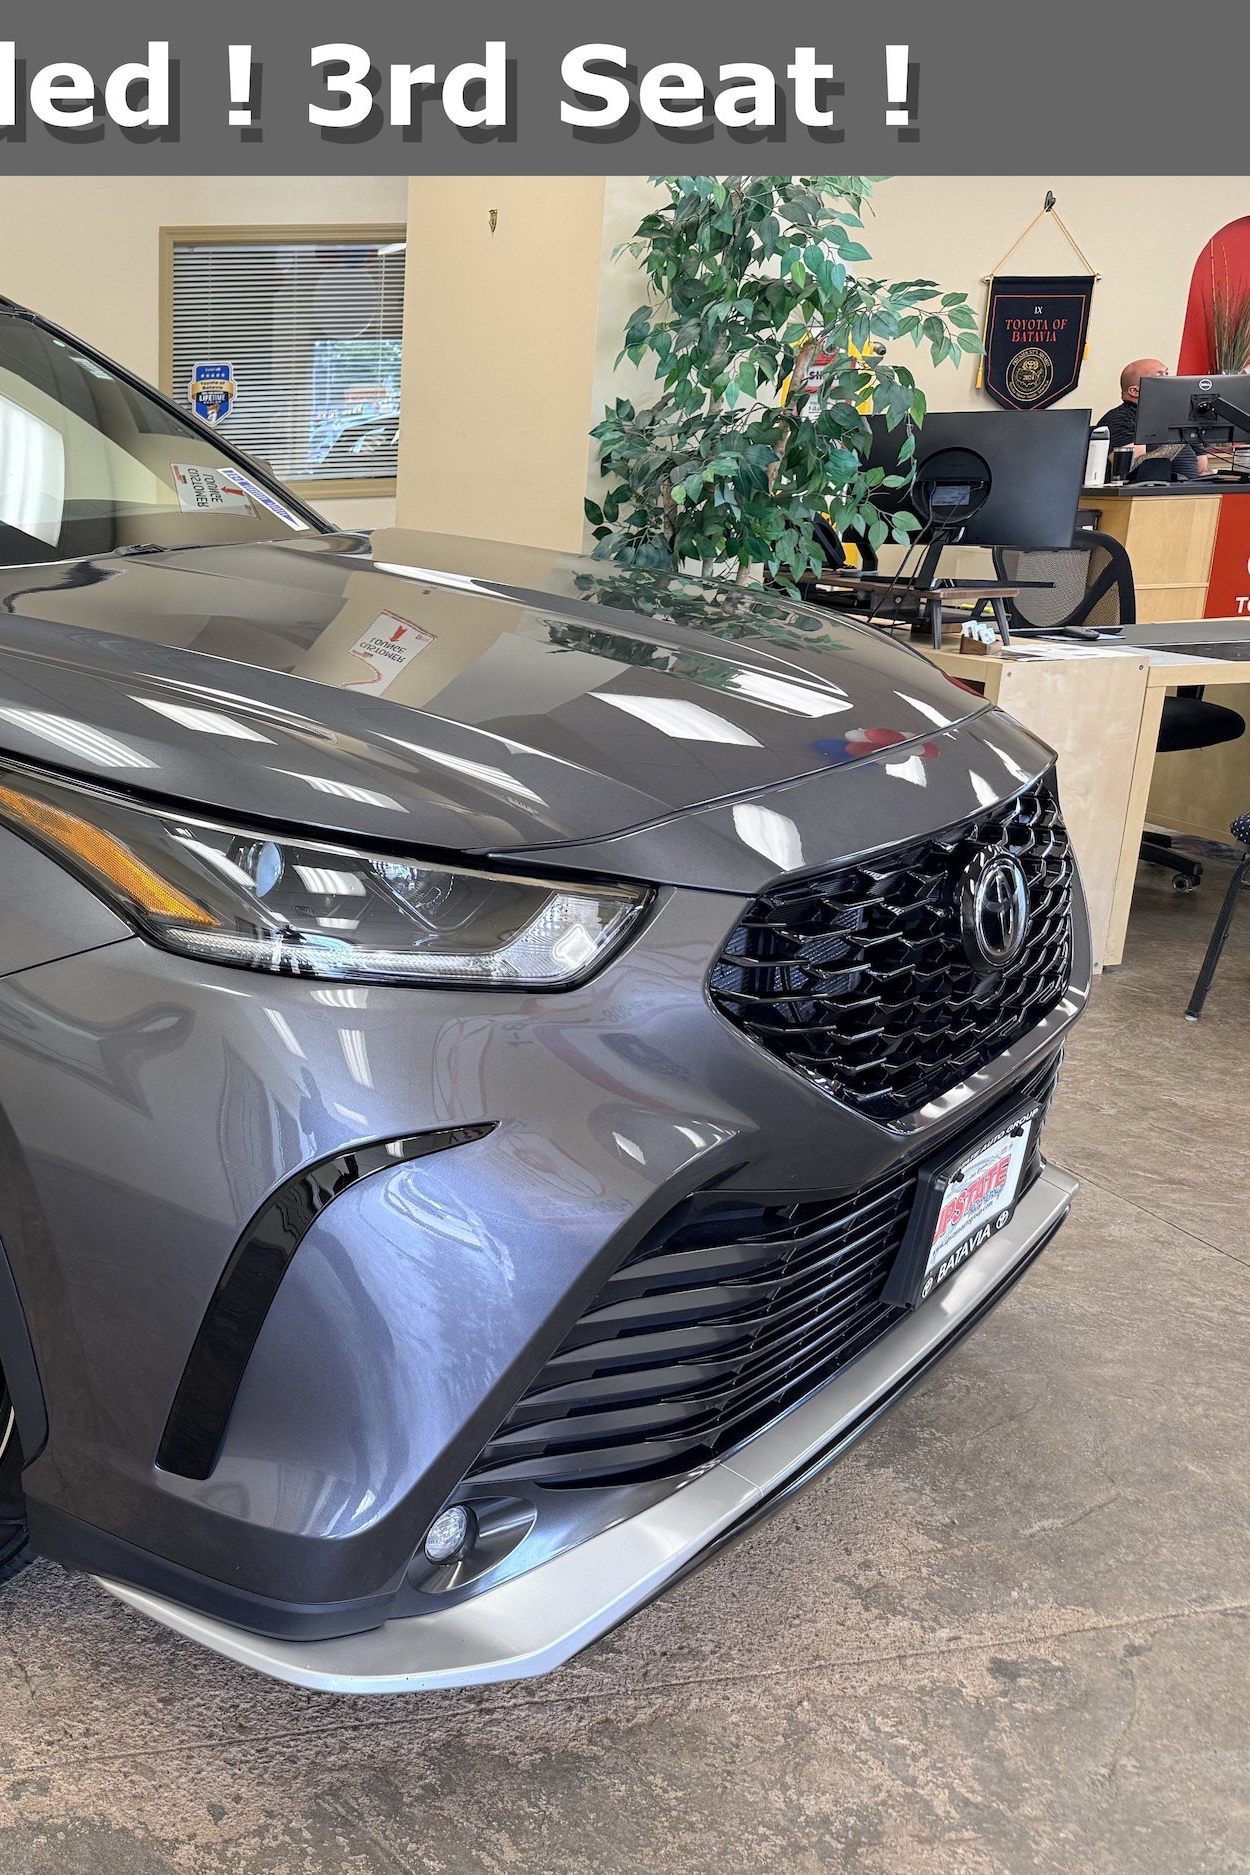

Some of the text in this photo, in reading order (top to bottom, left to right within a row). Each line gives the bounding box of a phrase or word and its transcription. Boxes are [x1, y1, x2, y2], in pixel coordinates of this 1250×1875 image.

[1005, 319, 1068, 330] TOYOTA OF
[1012, 331, 1057, 342] BATAVIA
[1005, 1107, 1039, 1134] GROUP
[936, 1224, 991, 1283] BATAVIA
